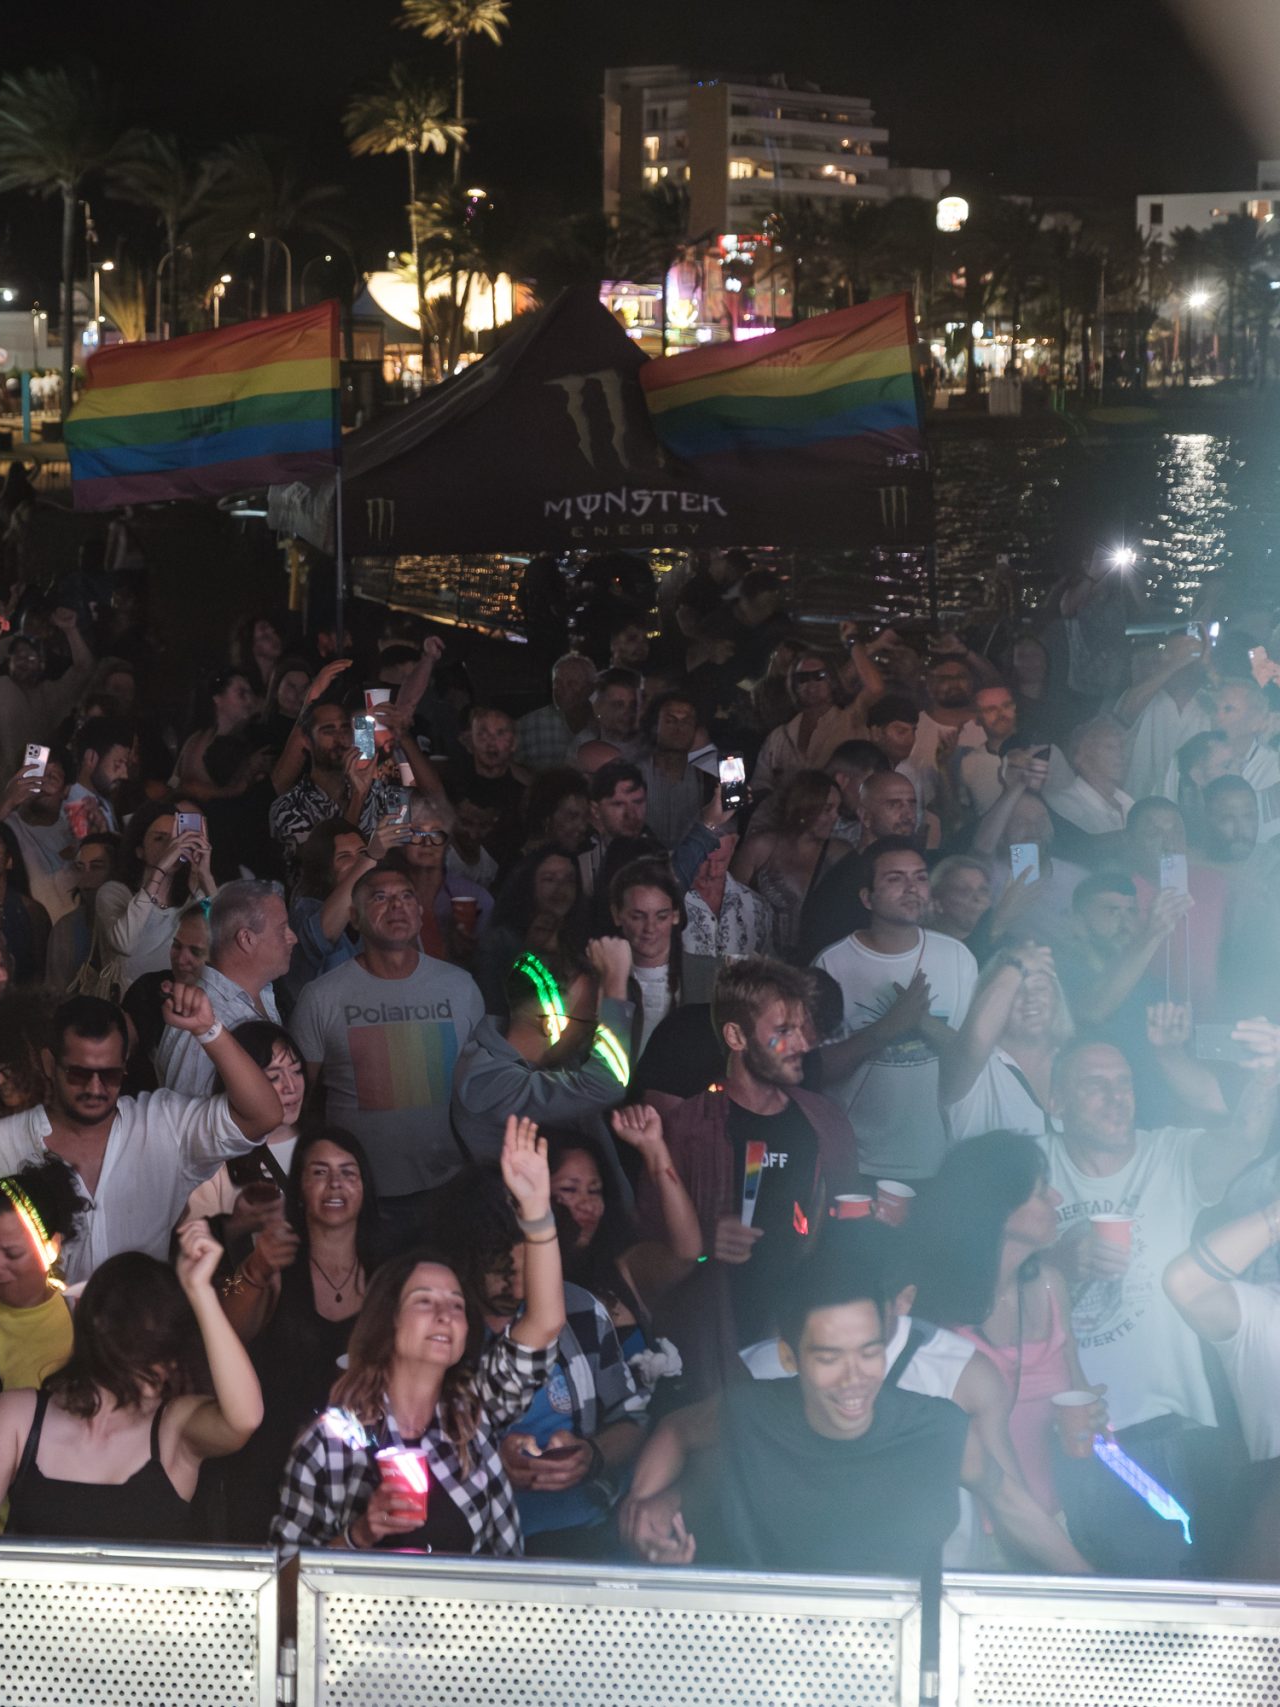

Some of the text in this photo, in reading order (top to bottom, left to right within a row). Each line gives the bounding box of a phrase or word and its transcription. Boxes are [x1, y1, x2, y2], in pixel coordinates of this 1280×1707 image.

[544, 486, 728, 520] MONSTER
[571, 523, 700, 538] ENERGY
[344, 999, 453, 1026] Polaroid
[1080, 1318, 1136, 1349] UERTE
